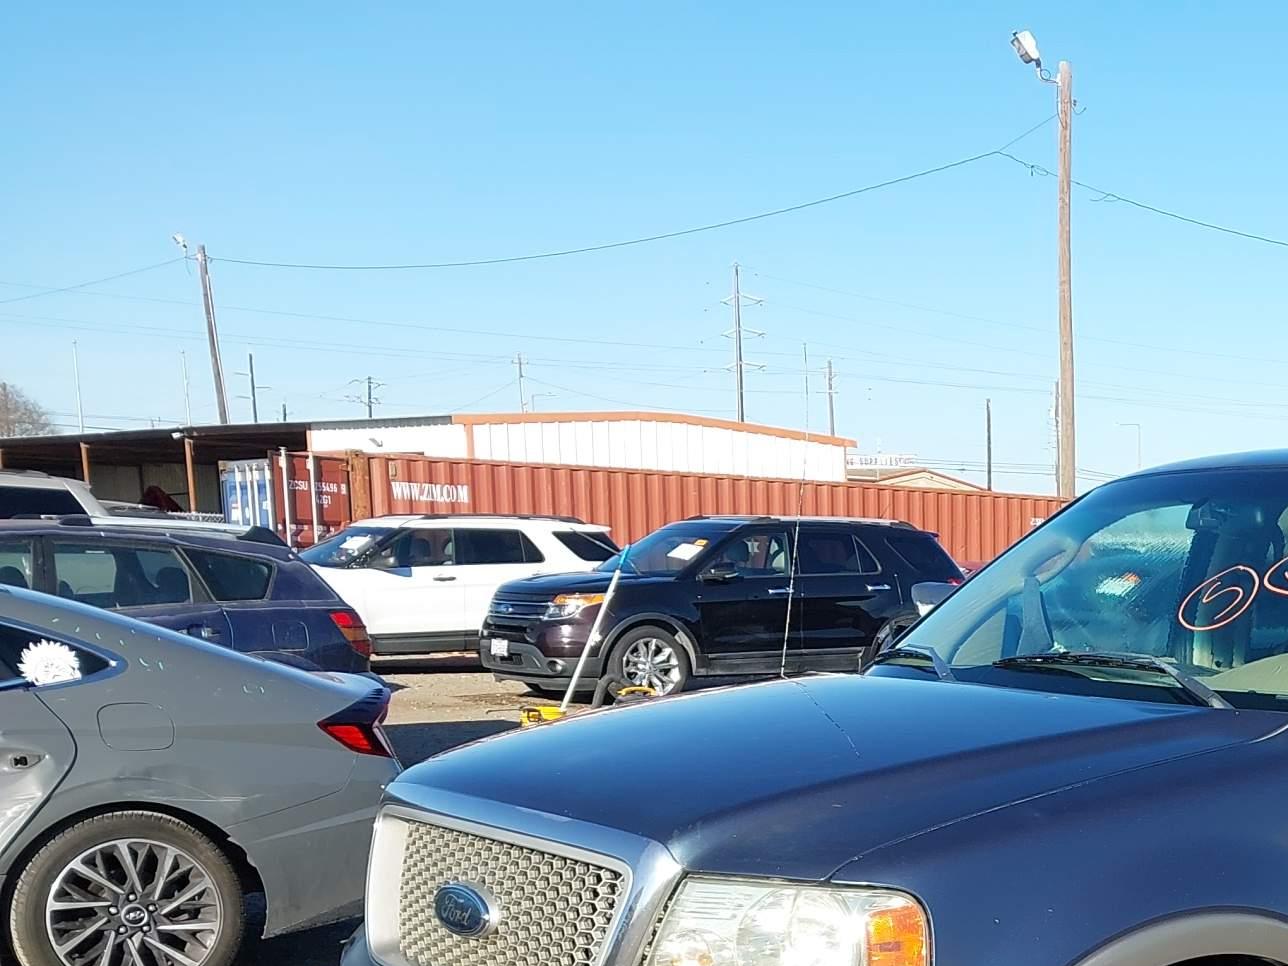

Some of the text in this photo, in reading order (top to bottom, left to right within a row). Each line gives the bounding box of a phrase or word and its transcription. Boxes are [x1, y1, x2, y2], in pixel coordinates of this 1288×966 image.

[289, 480, 309, 490] ZCSU
[391, 481, 468, 503] WWW.ZIM.COM
[441, 893, 472, 926] Ford
